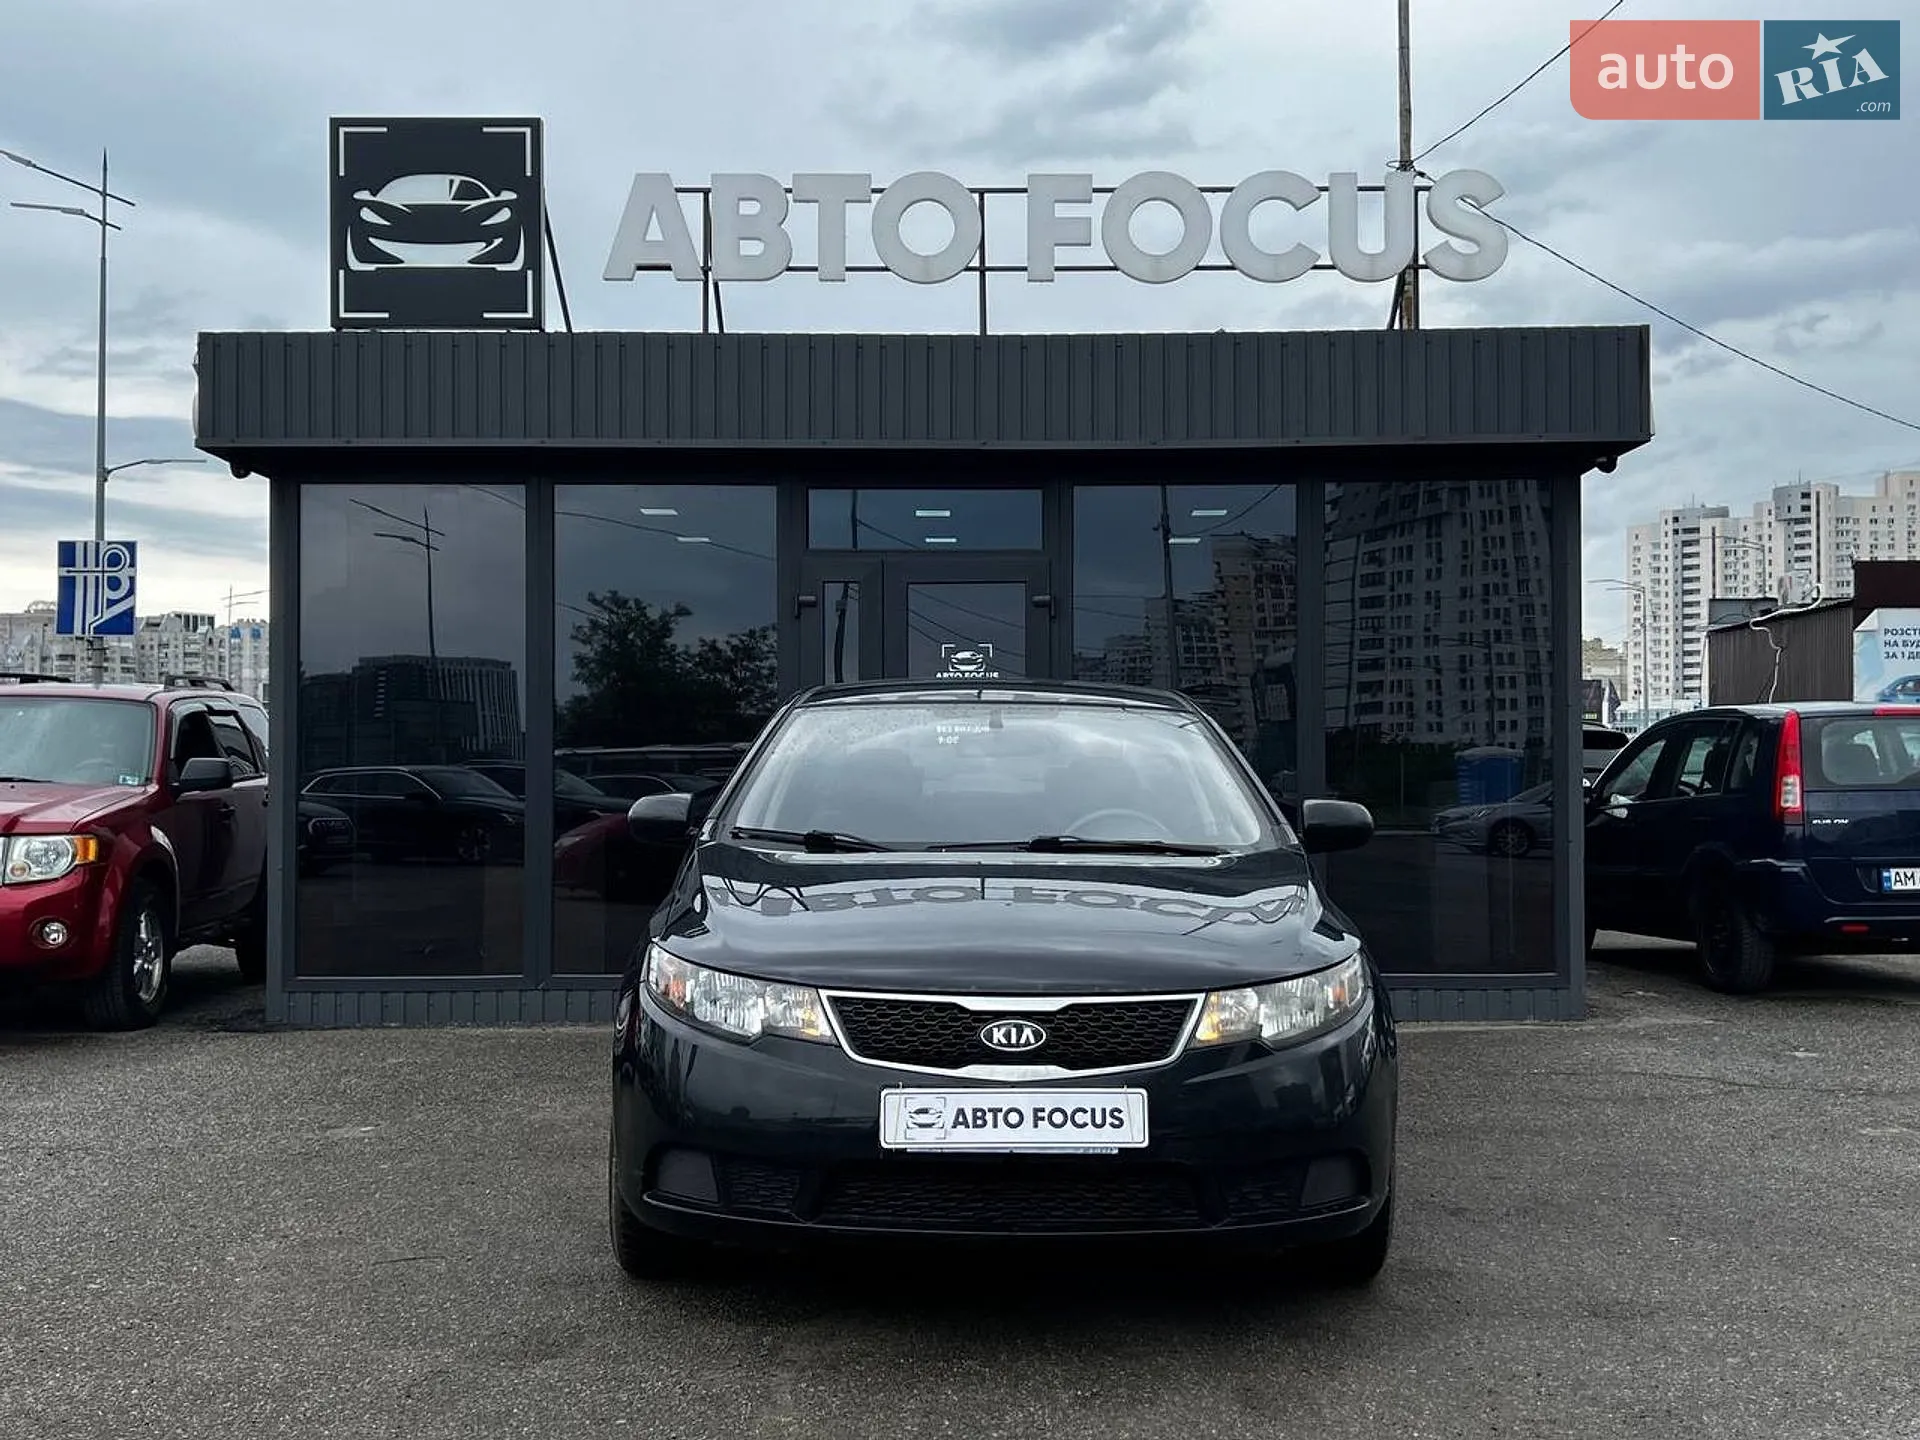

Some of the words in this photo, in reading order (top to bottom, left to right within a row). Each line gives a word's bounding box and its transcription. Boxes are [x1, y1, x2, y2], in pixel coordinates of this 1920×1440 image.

[602, 171, 982, 284] АВТО
[1027, 169, 1509, 284] FOCUS
[1884, 628, 1920, 636] РОЗСТ
[1884, 640, 1899, 648] НА
[1884, 651, 1898, 659] ЗА
[1894, 871, 1915, 886] AM
[992, 1027, 1036, 1044] KIA
[951, 1107, 1024, 1129] АВТО
[1032, 1107, 1125, 1129] FOCUS
